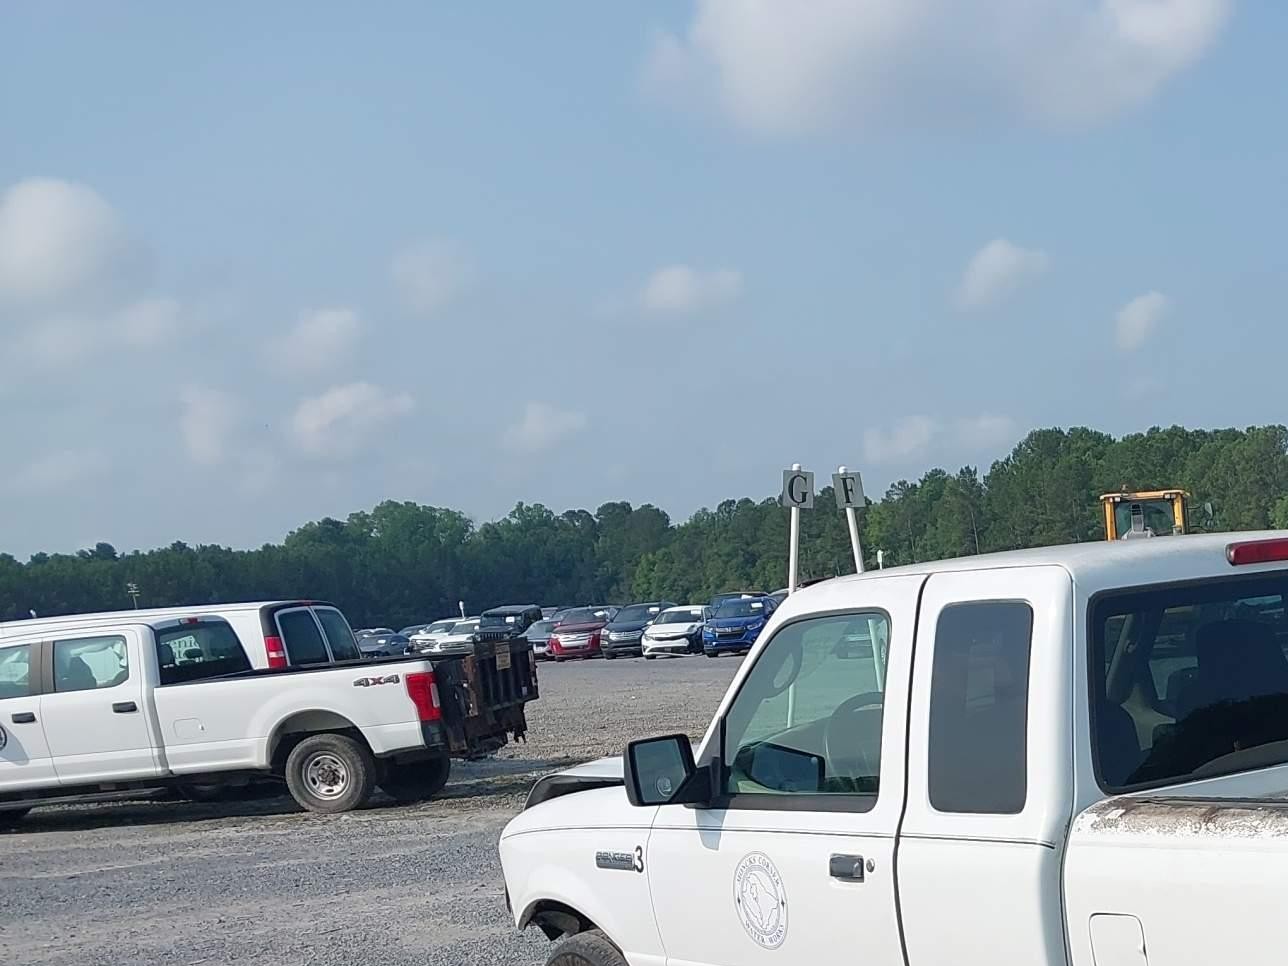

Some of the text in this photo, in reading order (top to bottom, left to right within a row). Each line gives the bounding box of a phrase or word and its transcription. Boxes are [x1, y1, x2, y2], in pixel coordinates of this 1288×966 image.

[787, 474, 809, 505] G
[840, 476, 856, 503] F
[634, 845, 645, 874] 3
